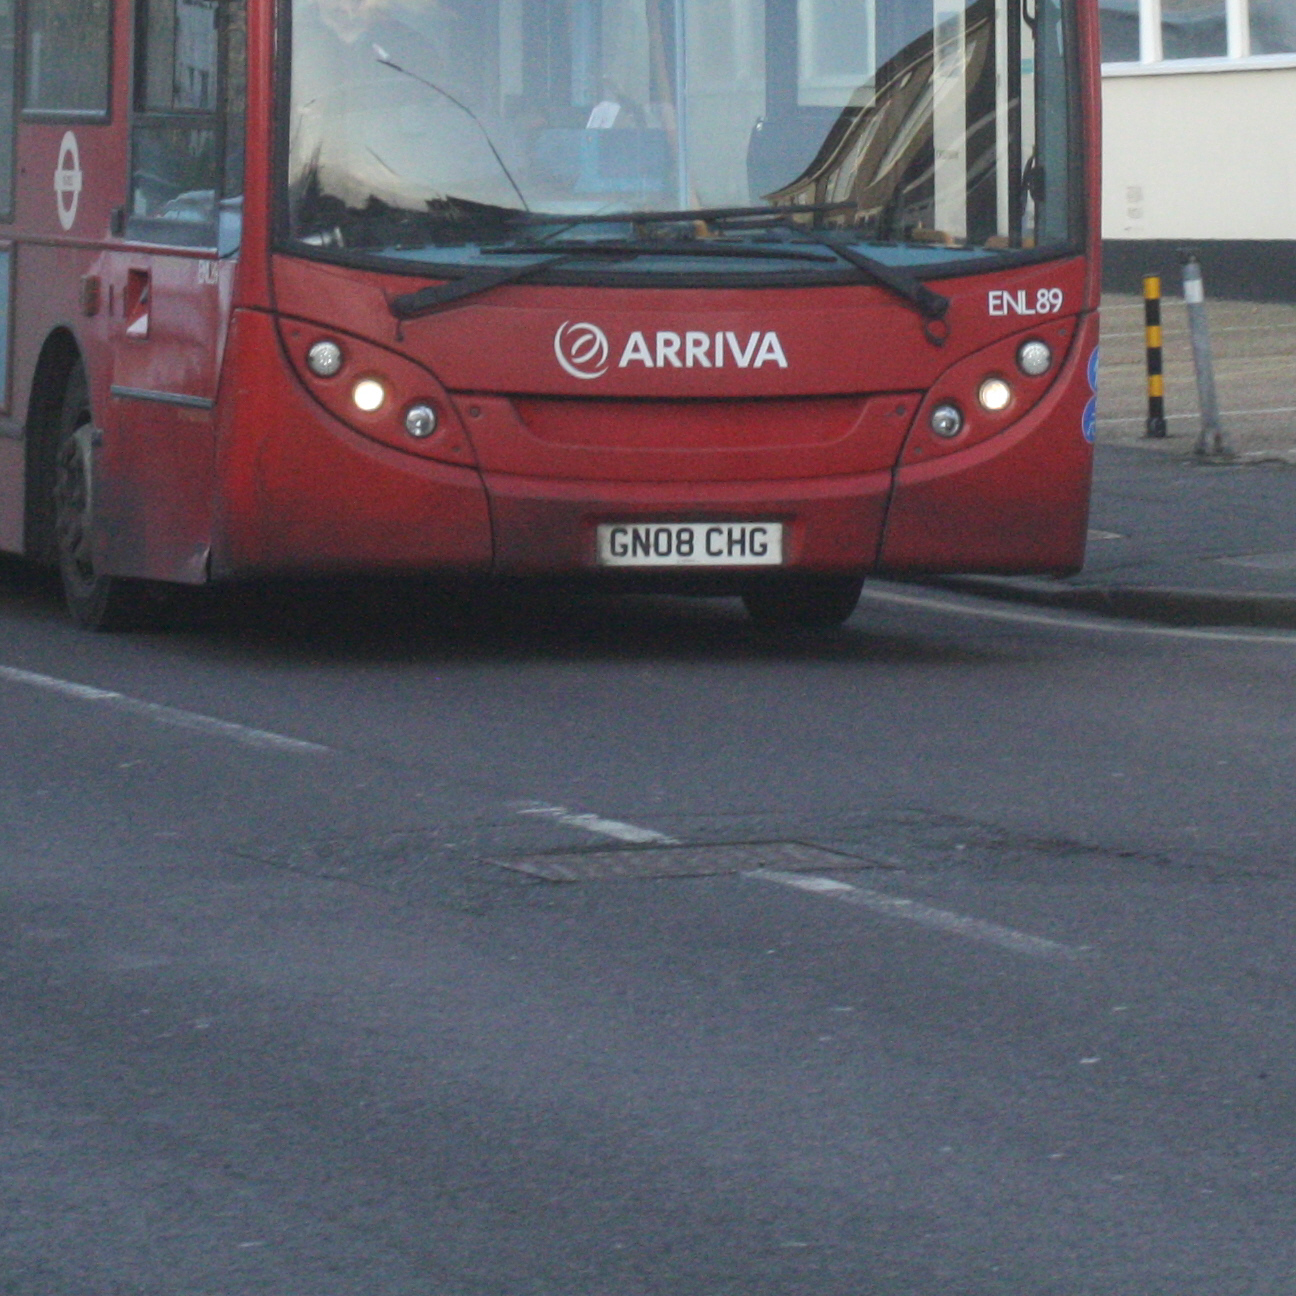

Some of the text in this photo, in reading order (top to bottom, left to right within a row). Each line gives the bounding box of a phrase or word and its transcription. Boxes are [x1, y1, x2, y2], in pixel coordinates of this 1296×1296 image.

[988, 287, 1063, 316] ENL89
[618, 330, 789, 368] ARRIVA
[609, 527, 768, 557] GN08 CHG
